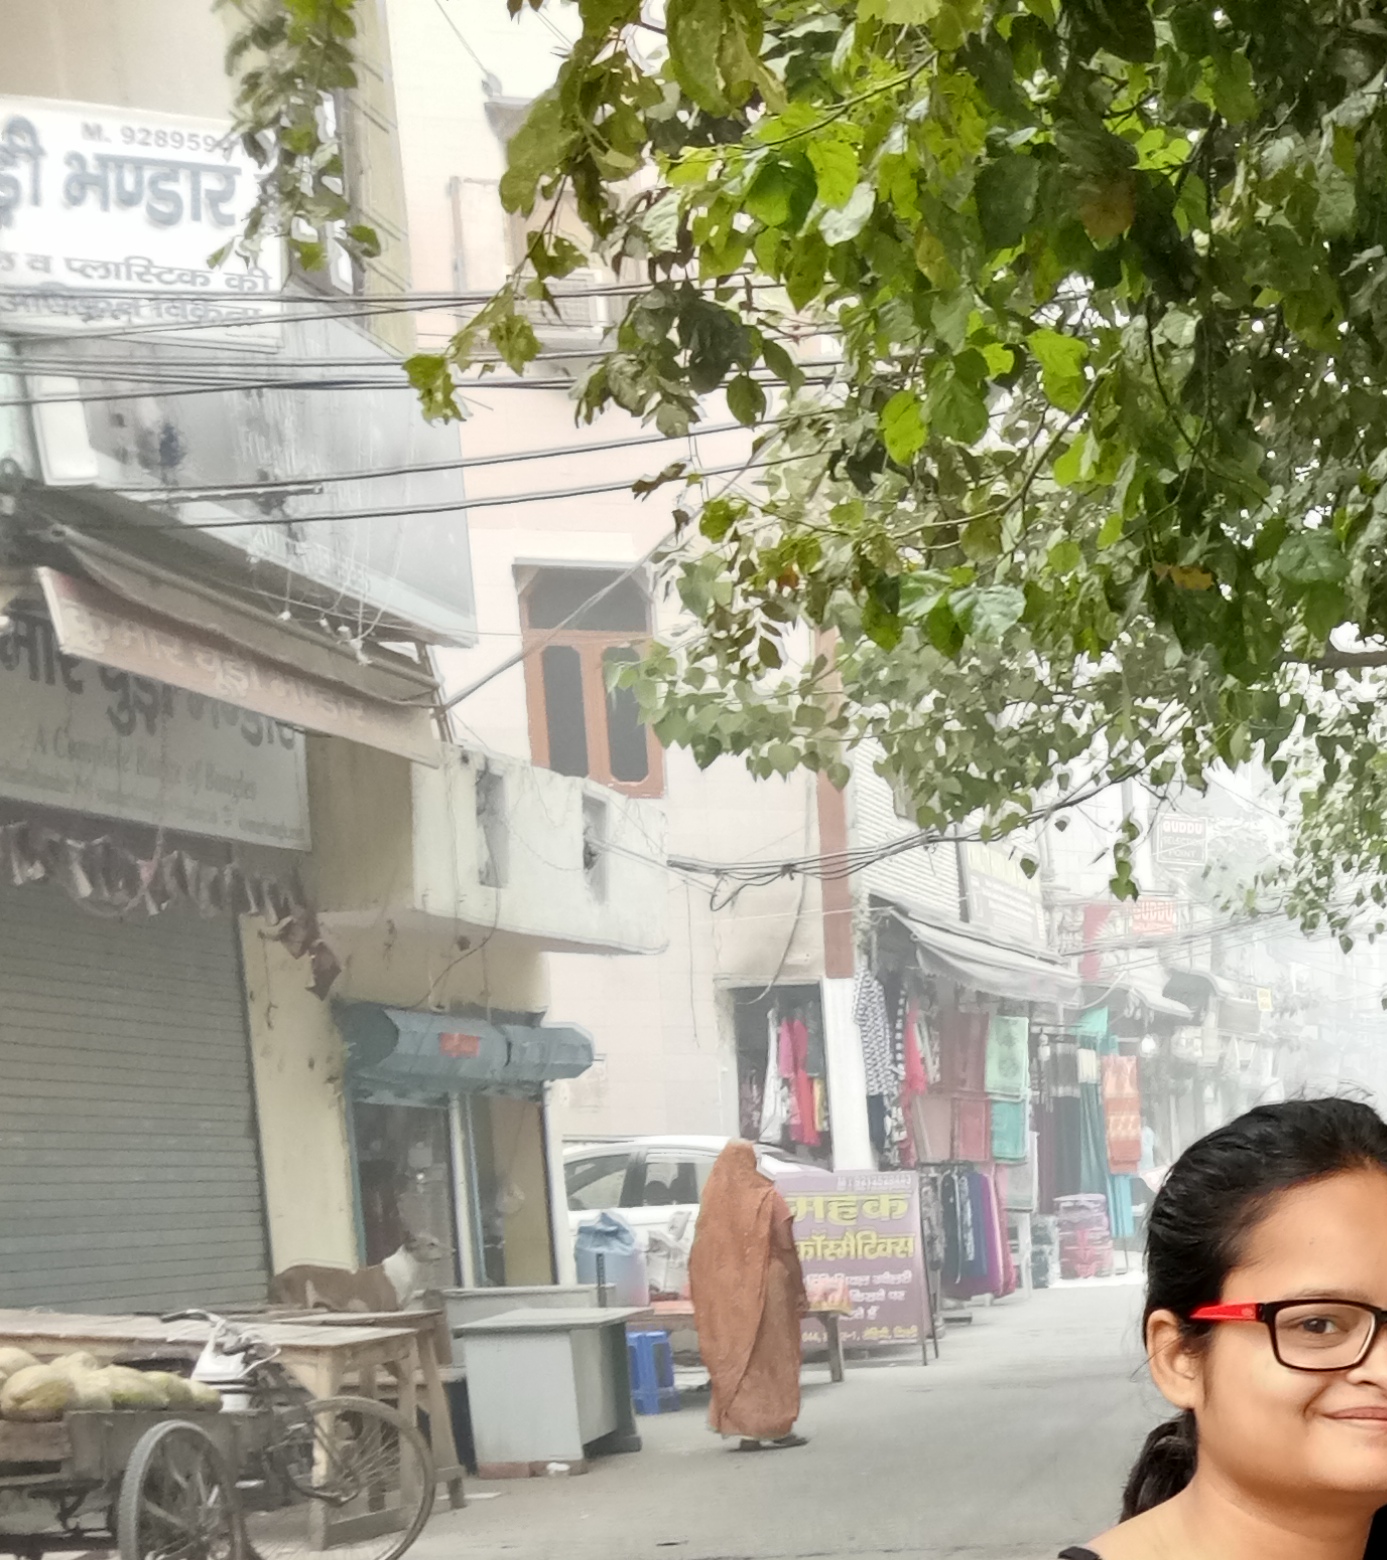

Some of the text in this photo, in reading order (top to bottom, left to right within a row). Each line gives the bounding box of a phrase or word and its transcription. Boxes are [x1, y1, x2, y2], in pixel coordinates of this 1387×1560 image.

[64, 151, 242, 227] भण्डार
[64, 255, 213, 287] प्लास्टिक
[223, 267, 272, 291] की
[786, 1194, 909, 1226] महक
